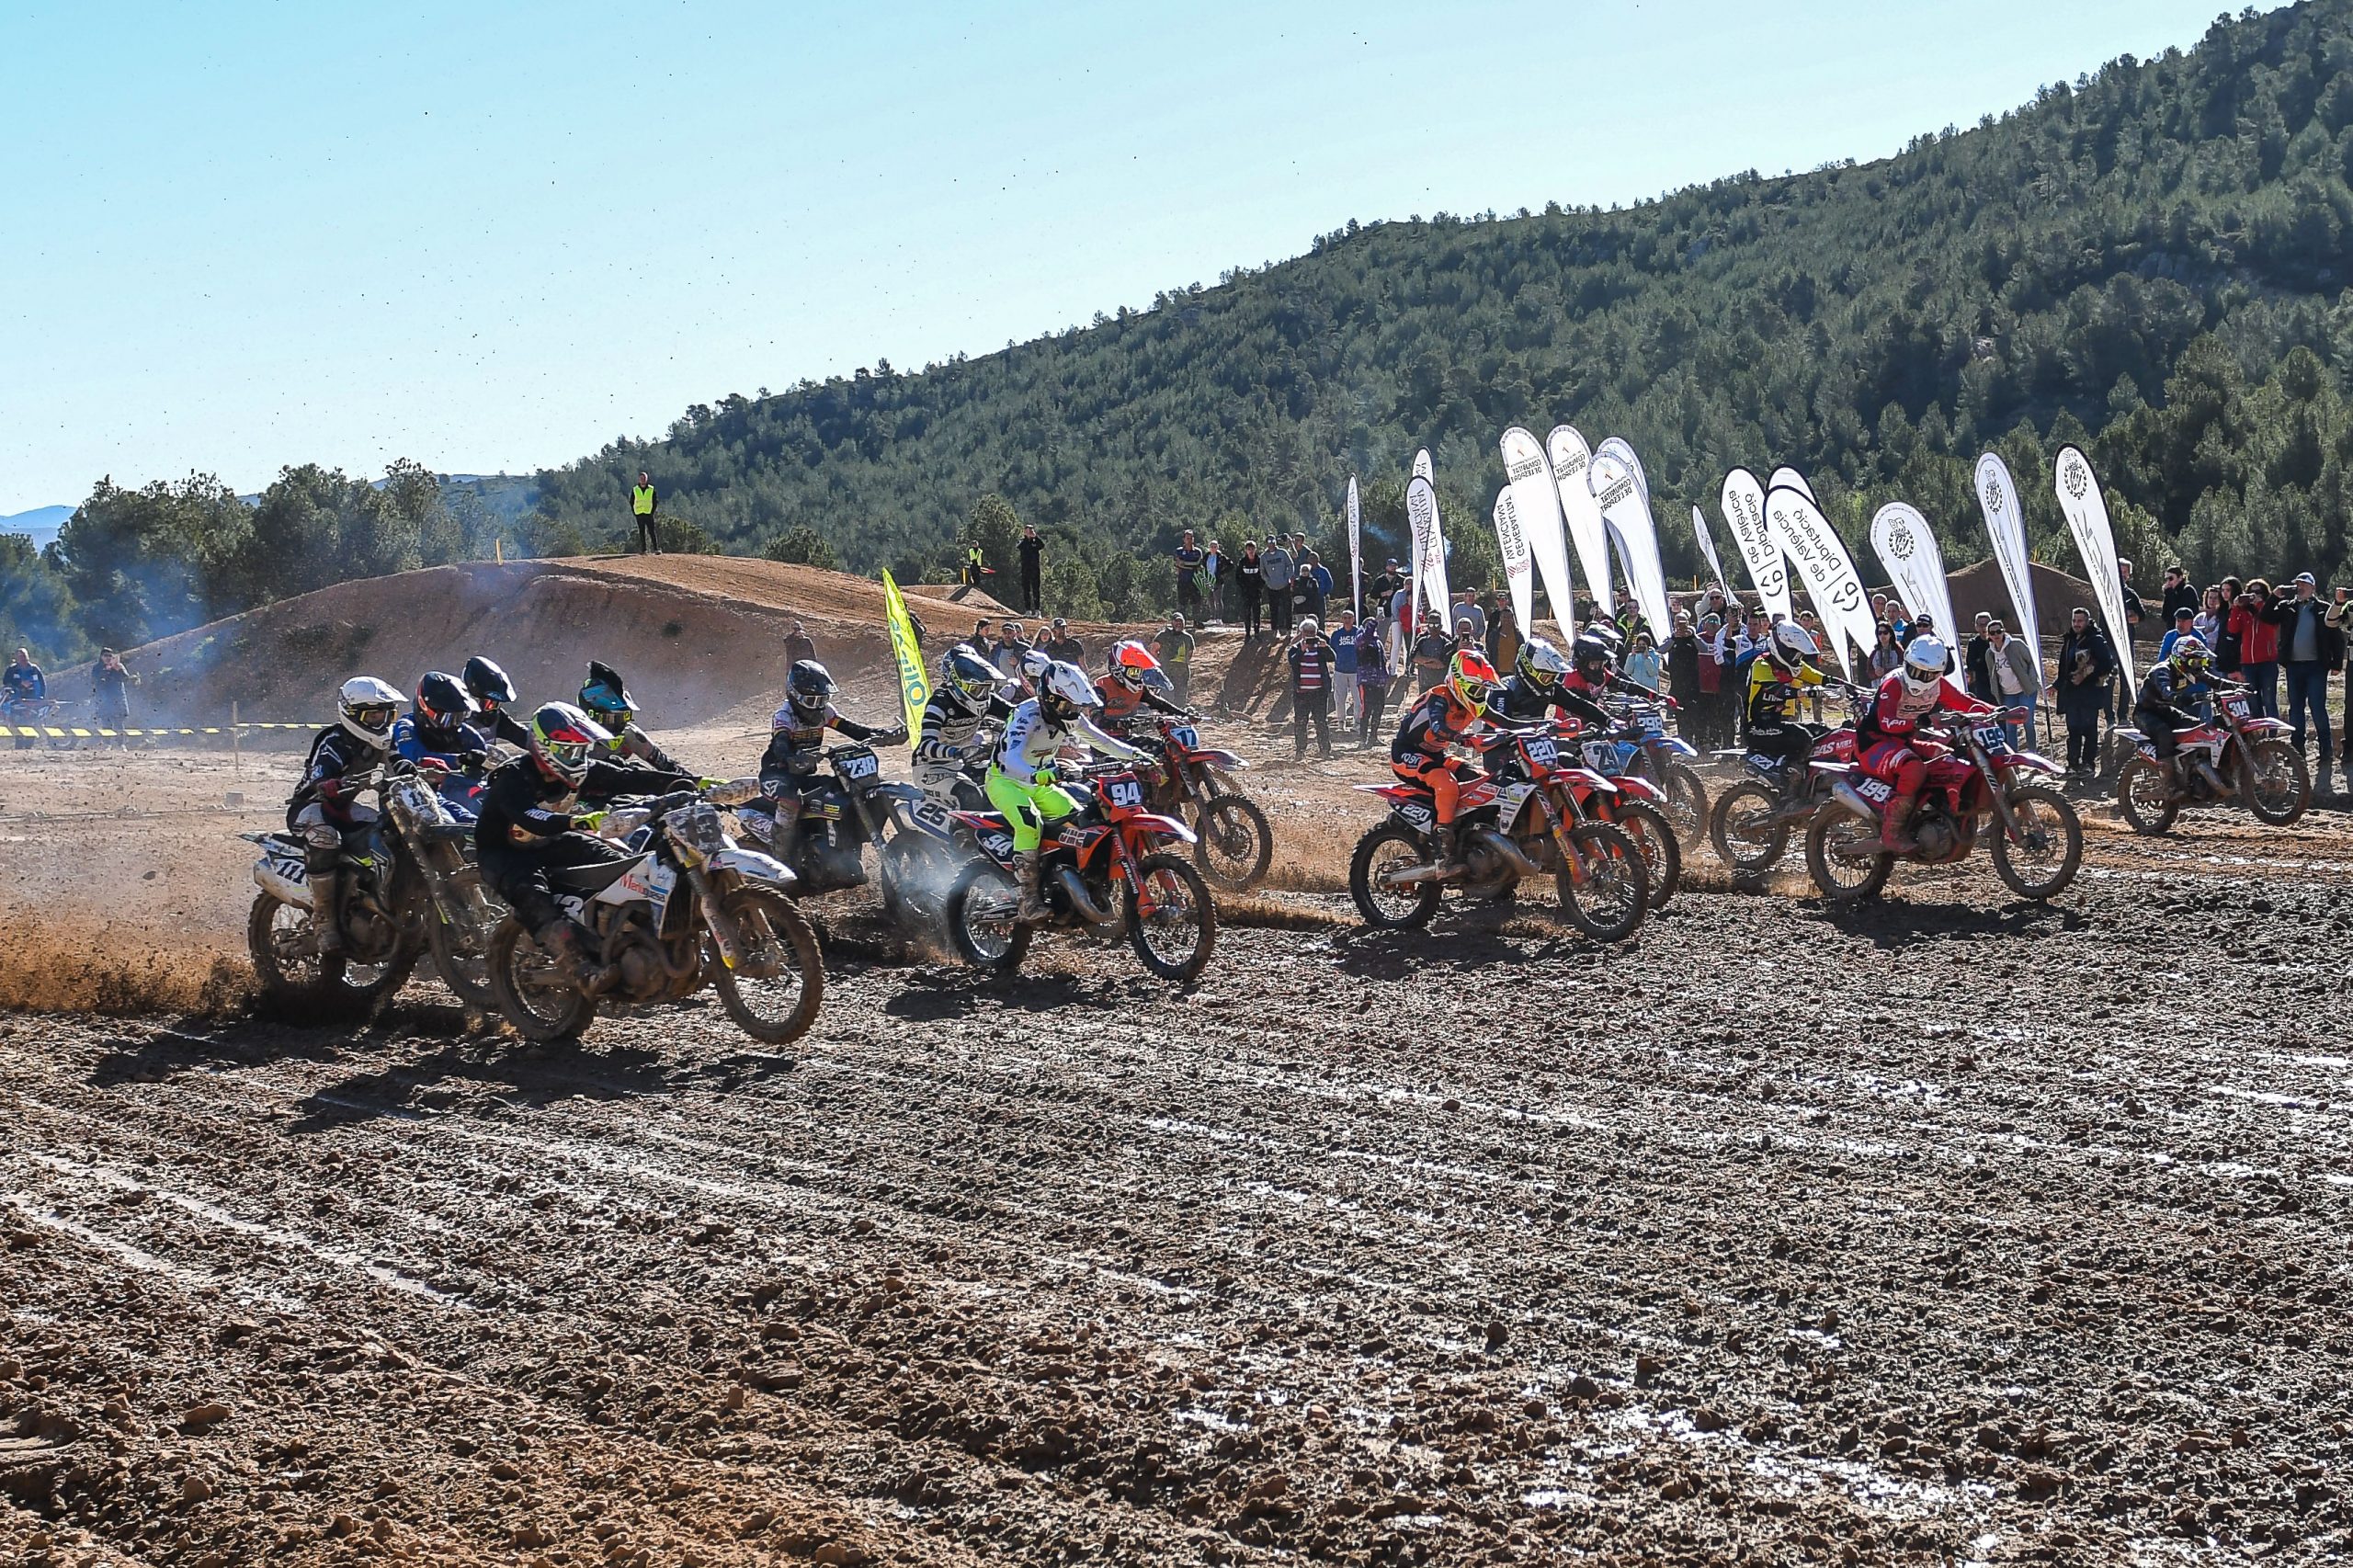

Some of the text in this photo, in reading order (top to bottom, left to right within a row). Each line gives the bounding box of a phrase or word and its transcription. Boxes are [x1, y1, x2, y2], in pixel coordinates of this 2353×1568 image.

[2228, 700, 2250, 718] 314
[1176, 727, 1197, 747] 17
[1978, 726, 2006, 748] 199
[1526, 740, 1557, 762] 220
[847, 756, 878, 779] 238
[1110, 781, 1142, 806] 94
[1856, 778, 1893, 802] 199
[524, 808, 552, 821] THOR
[916, 802, 949, 826] 25
[1401, 803, 1430, 822] 220
[983, 833, 1012, 857] 94
[276, 860, 306, 885] 111
